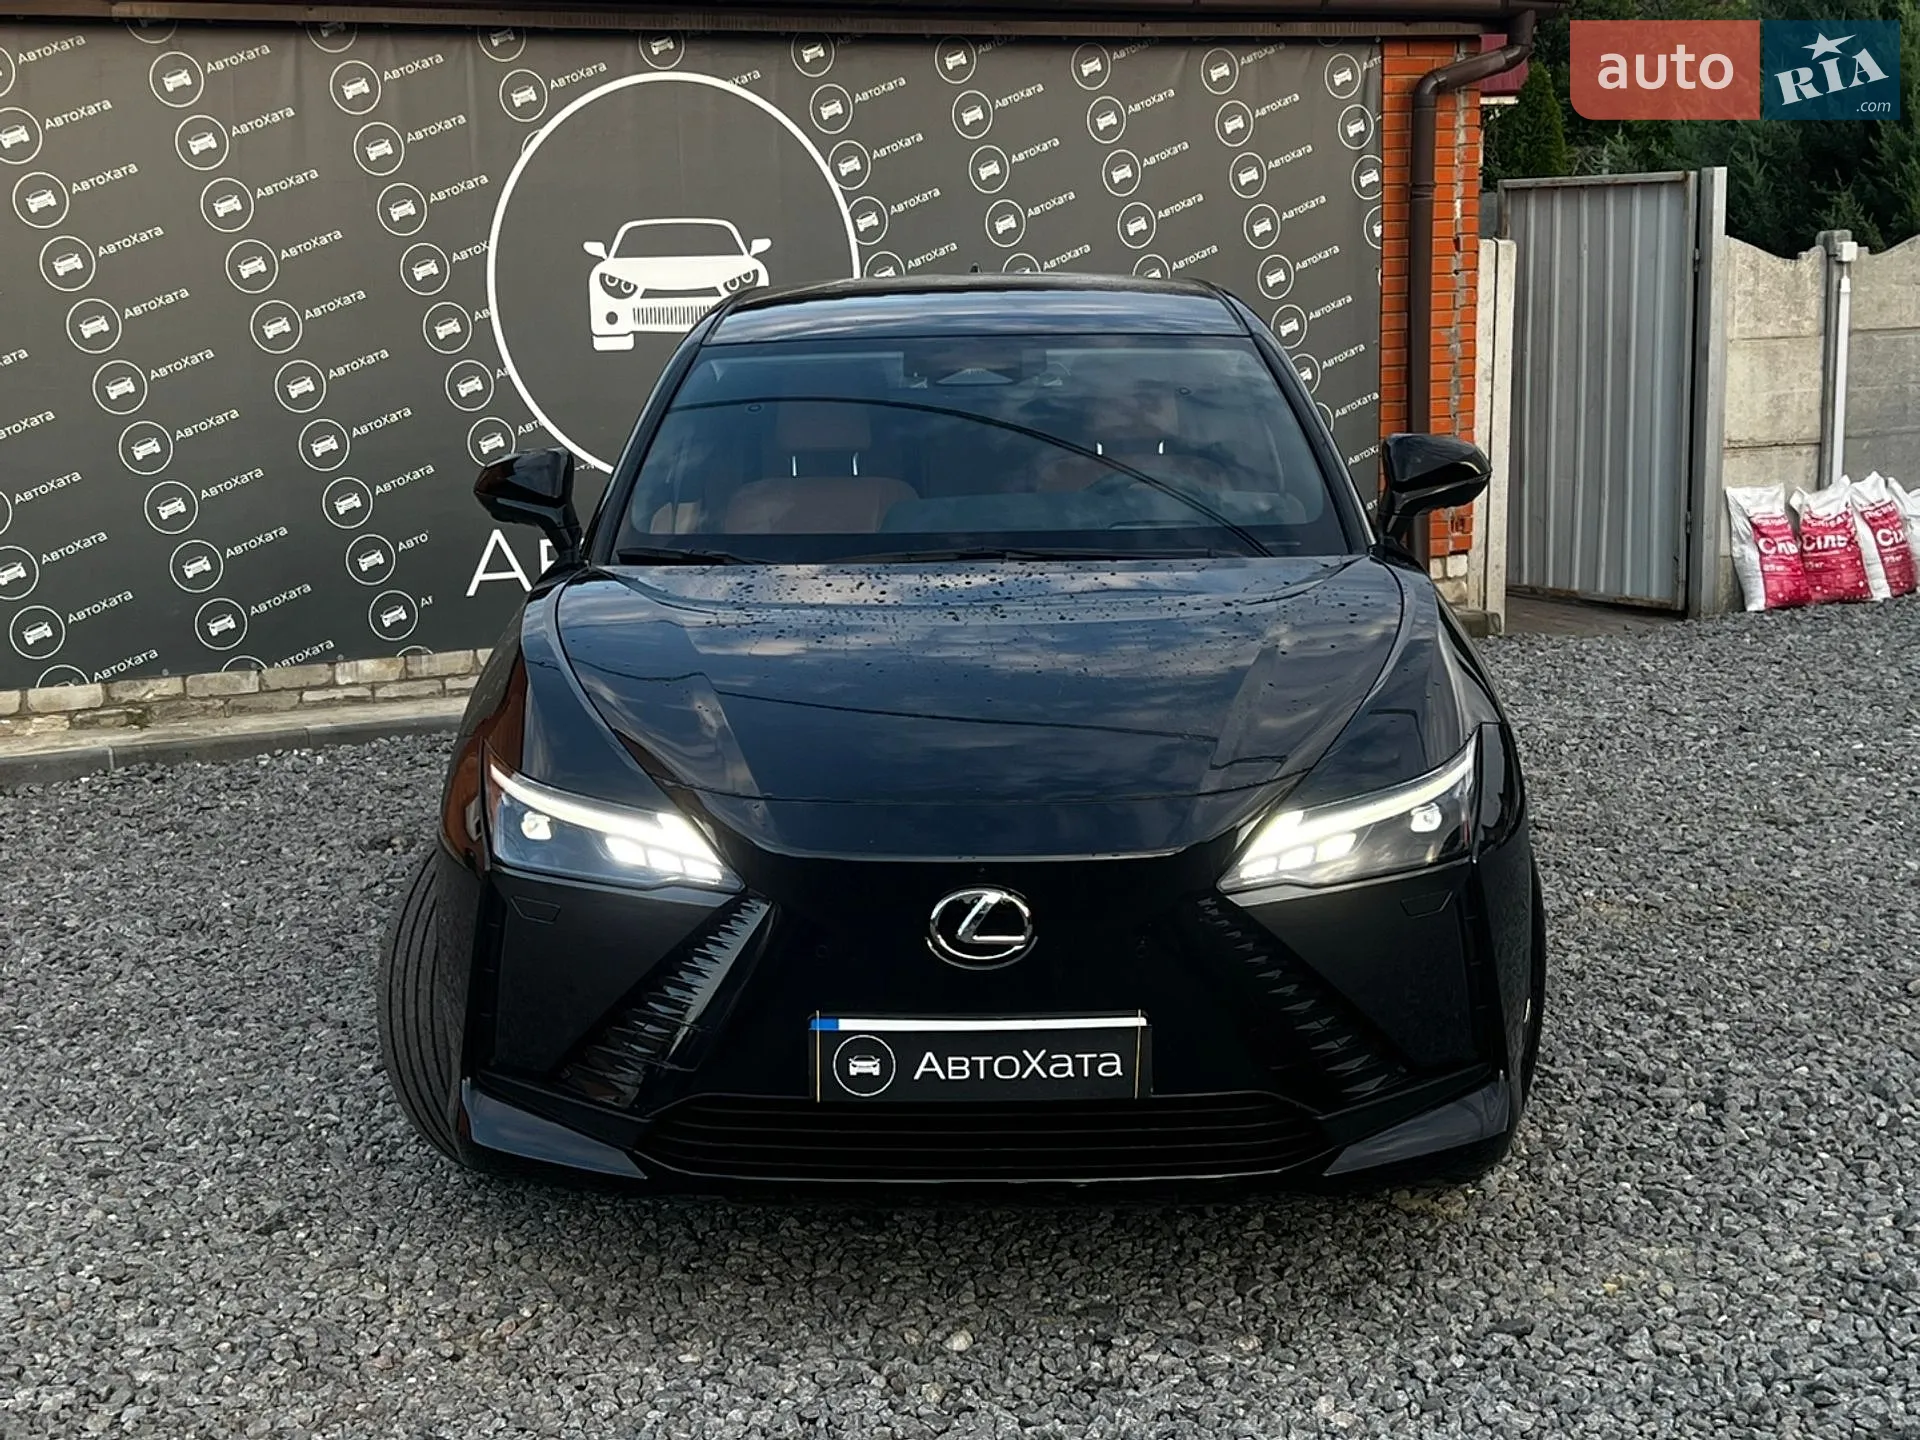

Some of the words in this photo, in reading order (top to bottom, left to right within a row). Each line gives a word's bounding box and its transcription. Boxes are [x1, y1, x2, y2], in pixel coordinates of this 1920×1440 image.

[19, 36, 85, 64] АвтоХата
[207, 45, 270, 73] АвтоХата
[384, 55, 443, 81] АвтоХата
[550, 61, 607, 90] АвтоХата
[855, 77, 905, 103] АвтоХата
[995, 84, 1043, 109] АвтоХата
[1128, 89, 1174, 114] АвтоХата
[46, 100, 112, 129] АвтоХата
[1255, 94, 1299, 117] АвтоХата
[232, 108, 294, 136] АвтоХата
[407, 115, 466, 143] АвтоХата
[873, 133, 923, 159] АвтоХата
[1012, 138, 1059, 163] АвтоХата
[1143, 142, 1189, 167] АвтоХата
[1267, 144, 1313, 171] АвтоХата
[72, 164, 138, 194] АвтоХата
[257, 170, 318, 198] АвтоХата
[430, 175, 488, 203] АвтоХата
[891, 188, 940, 215] АвтоХата
[1028, 192, 1075, 217] АвтоХата
[1158, 194, 1203, 219] АвтоХата
[1281, 195, 1326, 222] АвтоХата
[99, 227, 163, 257] АвтоХата
[281, 231, 342, 260] АвтоХата
[908, 243, 957, 269] АвтоХата
[1042, 243, 1090, 271] АвтоХата
[1172, 245, 1217, 271] АвтоХата
[1296, 246, 1339, 271] АвтоХата
[125, 289, 189, 319] АвтоХата
[306, 291, 366, 320] АвтоХата
[1309, 296, 1352, 320] АвтоХата
[151, 349, 214, 380] АвтоХата
[329, 350, 389, 379] АвтоХата
[1323, 344, 1365, 369] АвтоХата
[1336, 392, 1379, 417] АвтоХата
[176, 410, 239, 440] АвтоХата
[353, 408, 411, 437] АвтоХата
[15, 472, 81, 504] АвтоХата
[202, 468, 263, 500] АвтоХата
[376, 465, 434, 495] АвтоХата
[42, 532, 107, 564] АвтоХата
[227, 527, 287, 558] АвтоХата
[398, 530, 428, 552] Авто
[69, 591, 133, 623] АвтоХата
[251, 584, 311, 616] АвтоХата
[93, 649, 159, 683] АвтоХата
[914, 1050, 1122, 1079] АвтоХата
